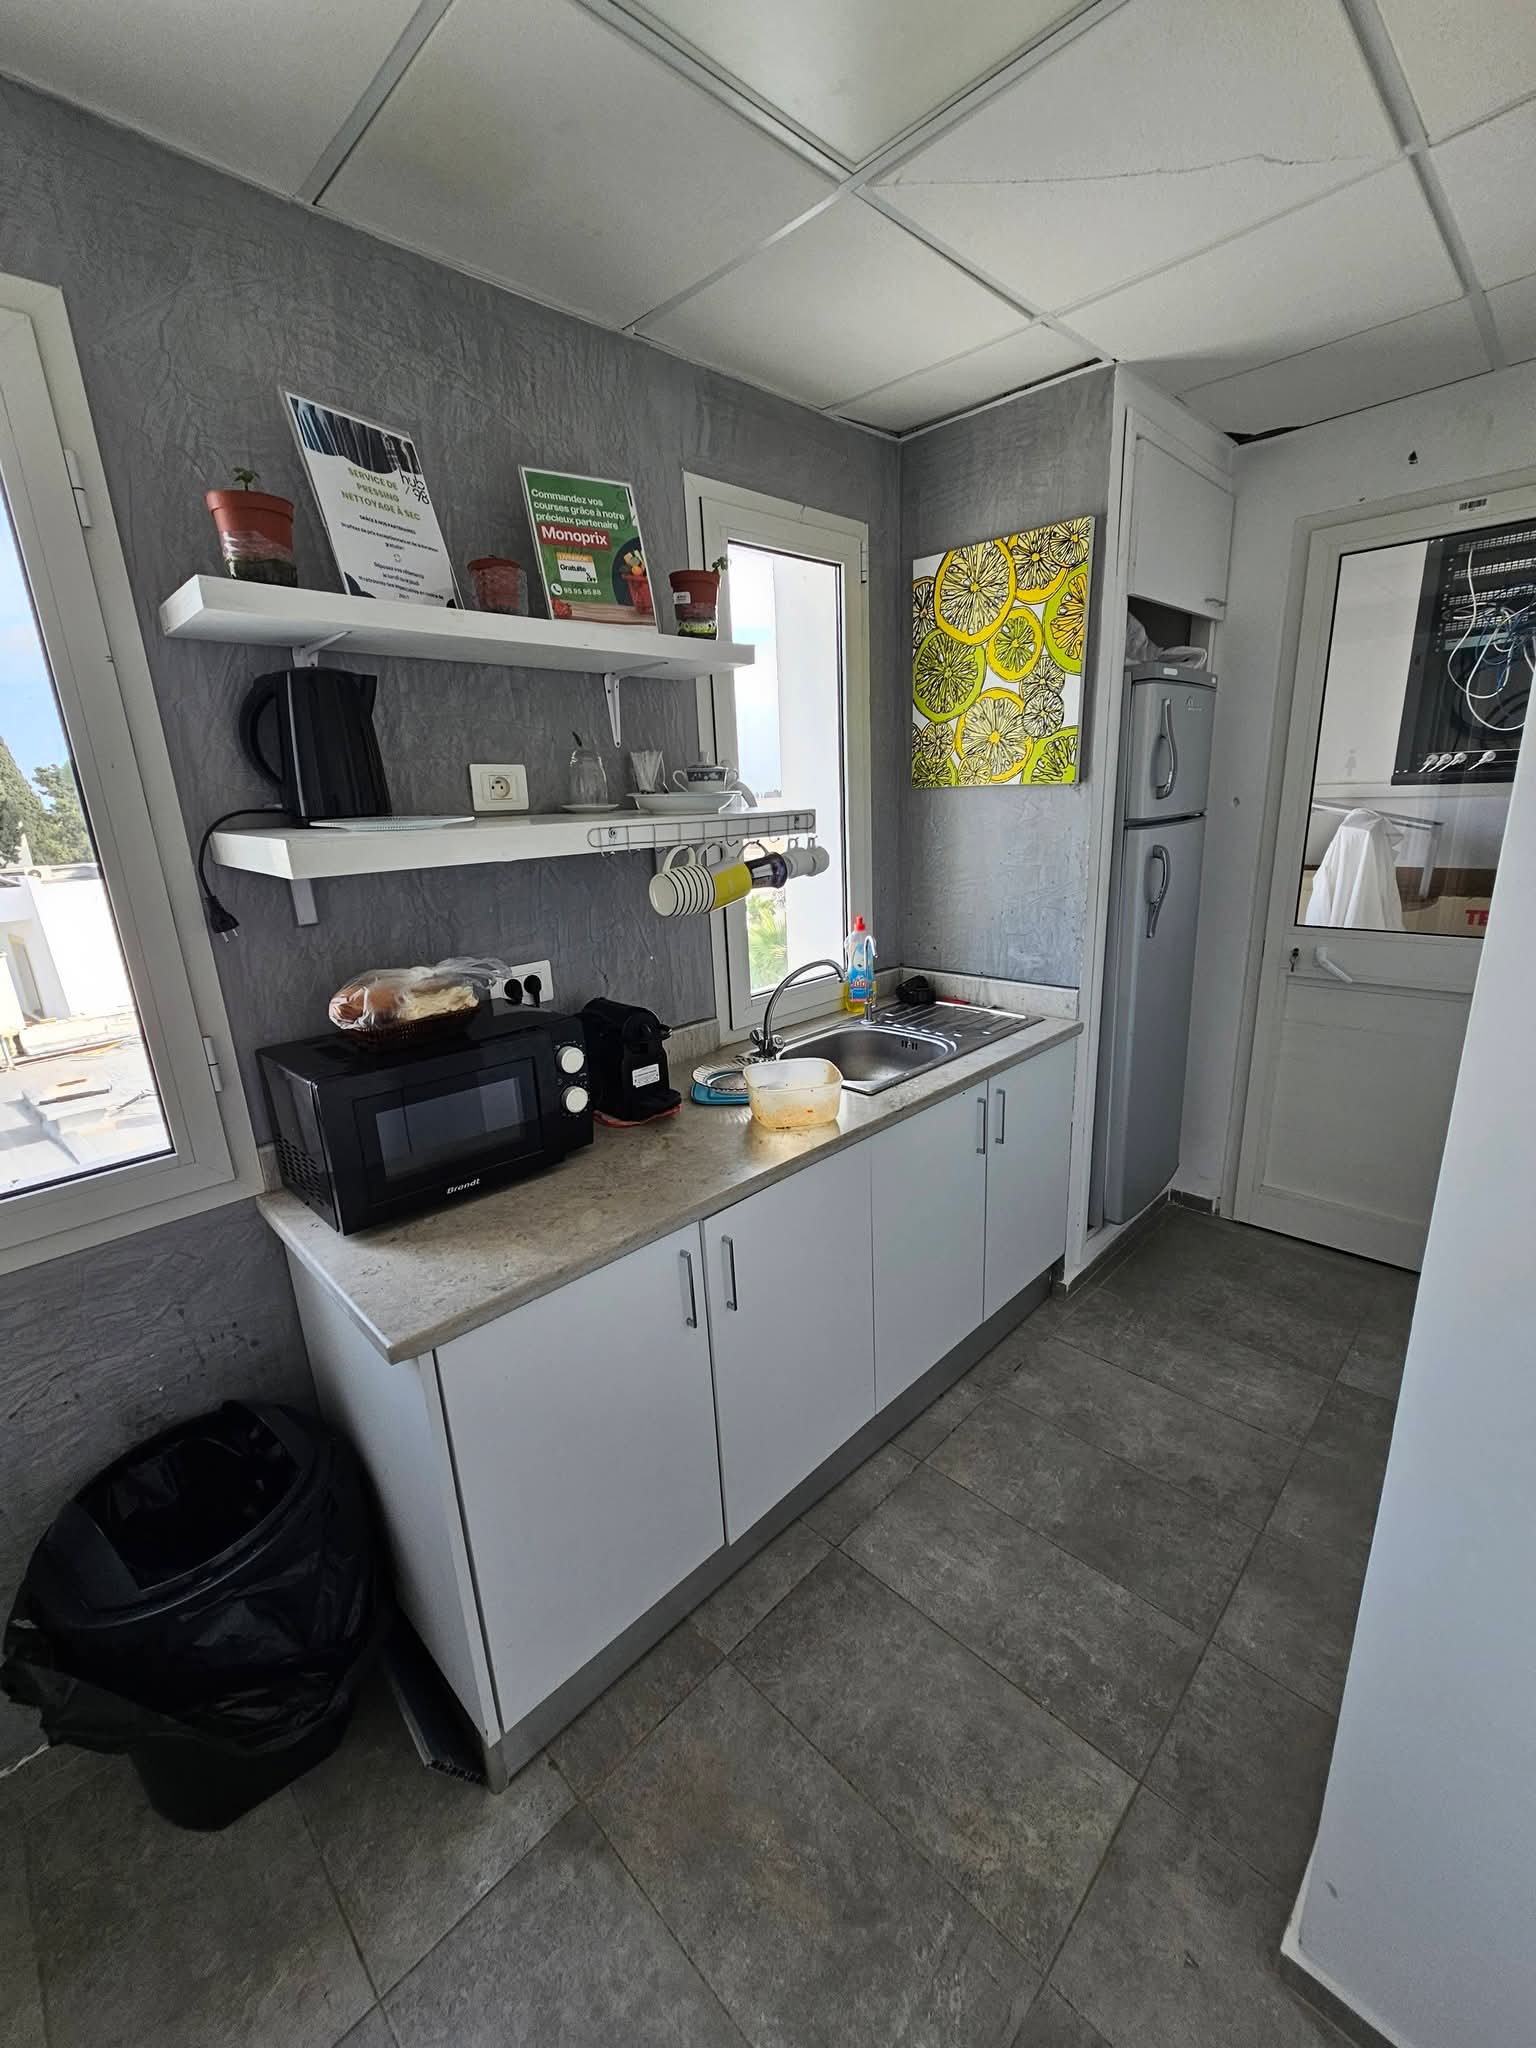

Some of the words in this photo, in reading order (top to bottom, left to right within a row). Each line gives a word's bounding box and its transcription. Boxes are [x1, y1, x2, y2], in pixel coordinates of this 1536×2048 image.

[347, 467, 386, 486] SERVICE
[386, 480, 399, 490] DE
[356, 482, 399, 502] PRESSING
[531, 488, 587, 504] Commandez
[587, 498, 604, 506] vos
[341, 490, 396, 513] NETTOYAGE
[404, 509, 421, 520] SEC
[533, 501, 570, 512] courses
[570, 505, 595, 517] grâce
[602, 511, 625, 520] notre
[535, 512, 575, 524] précieux
[575, 517, 619, 530] partenaire
[541, 525, 608, 546] Monoprix
[447, 1178, 480, 1195] Brandt
